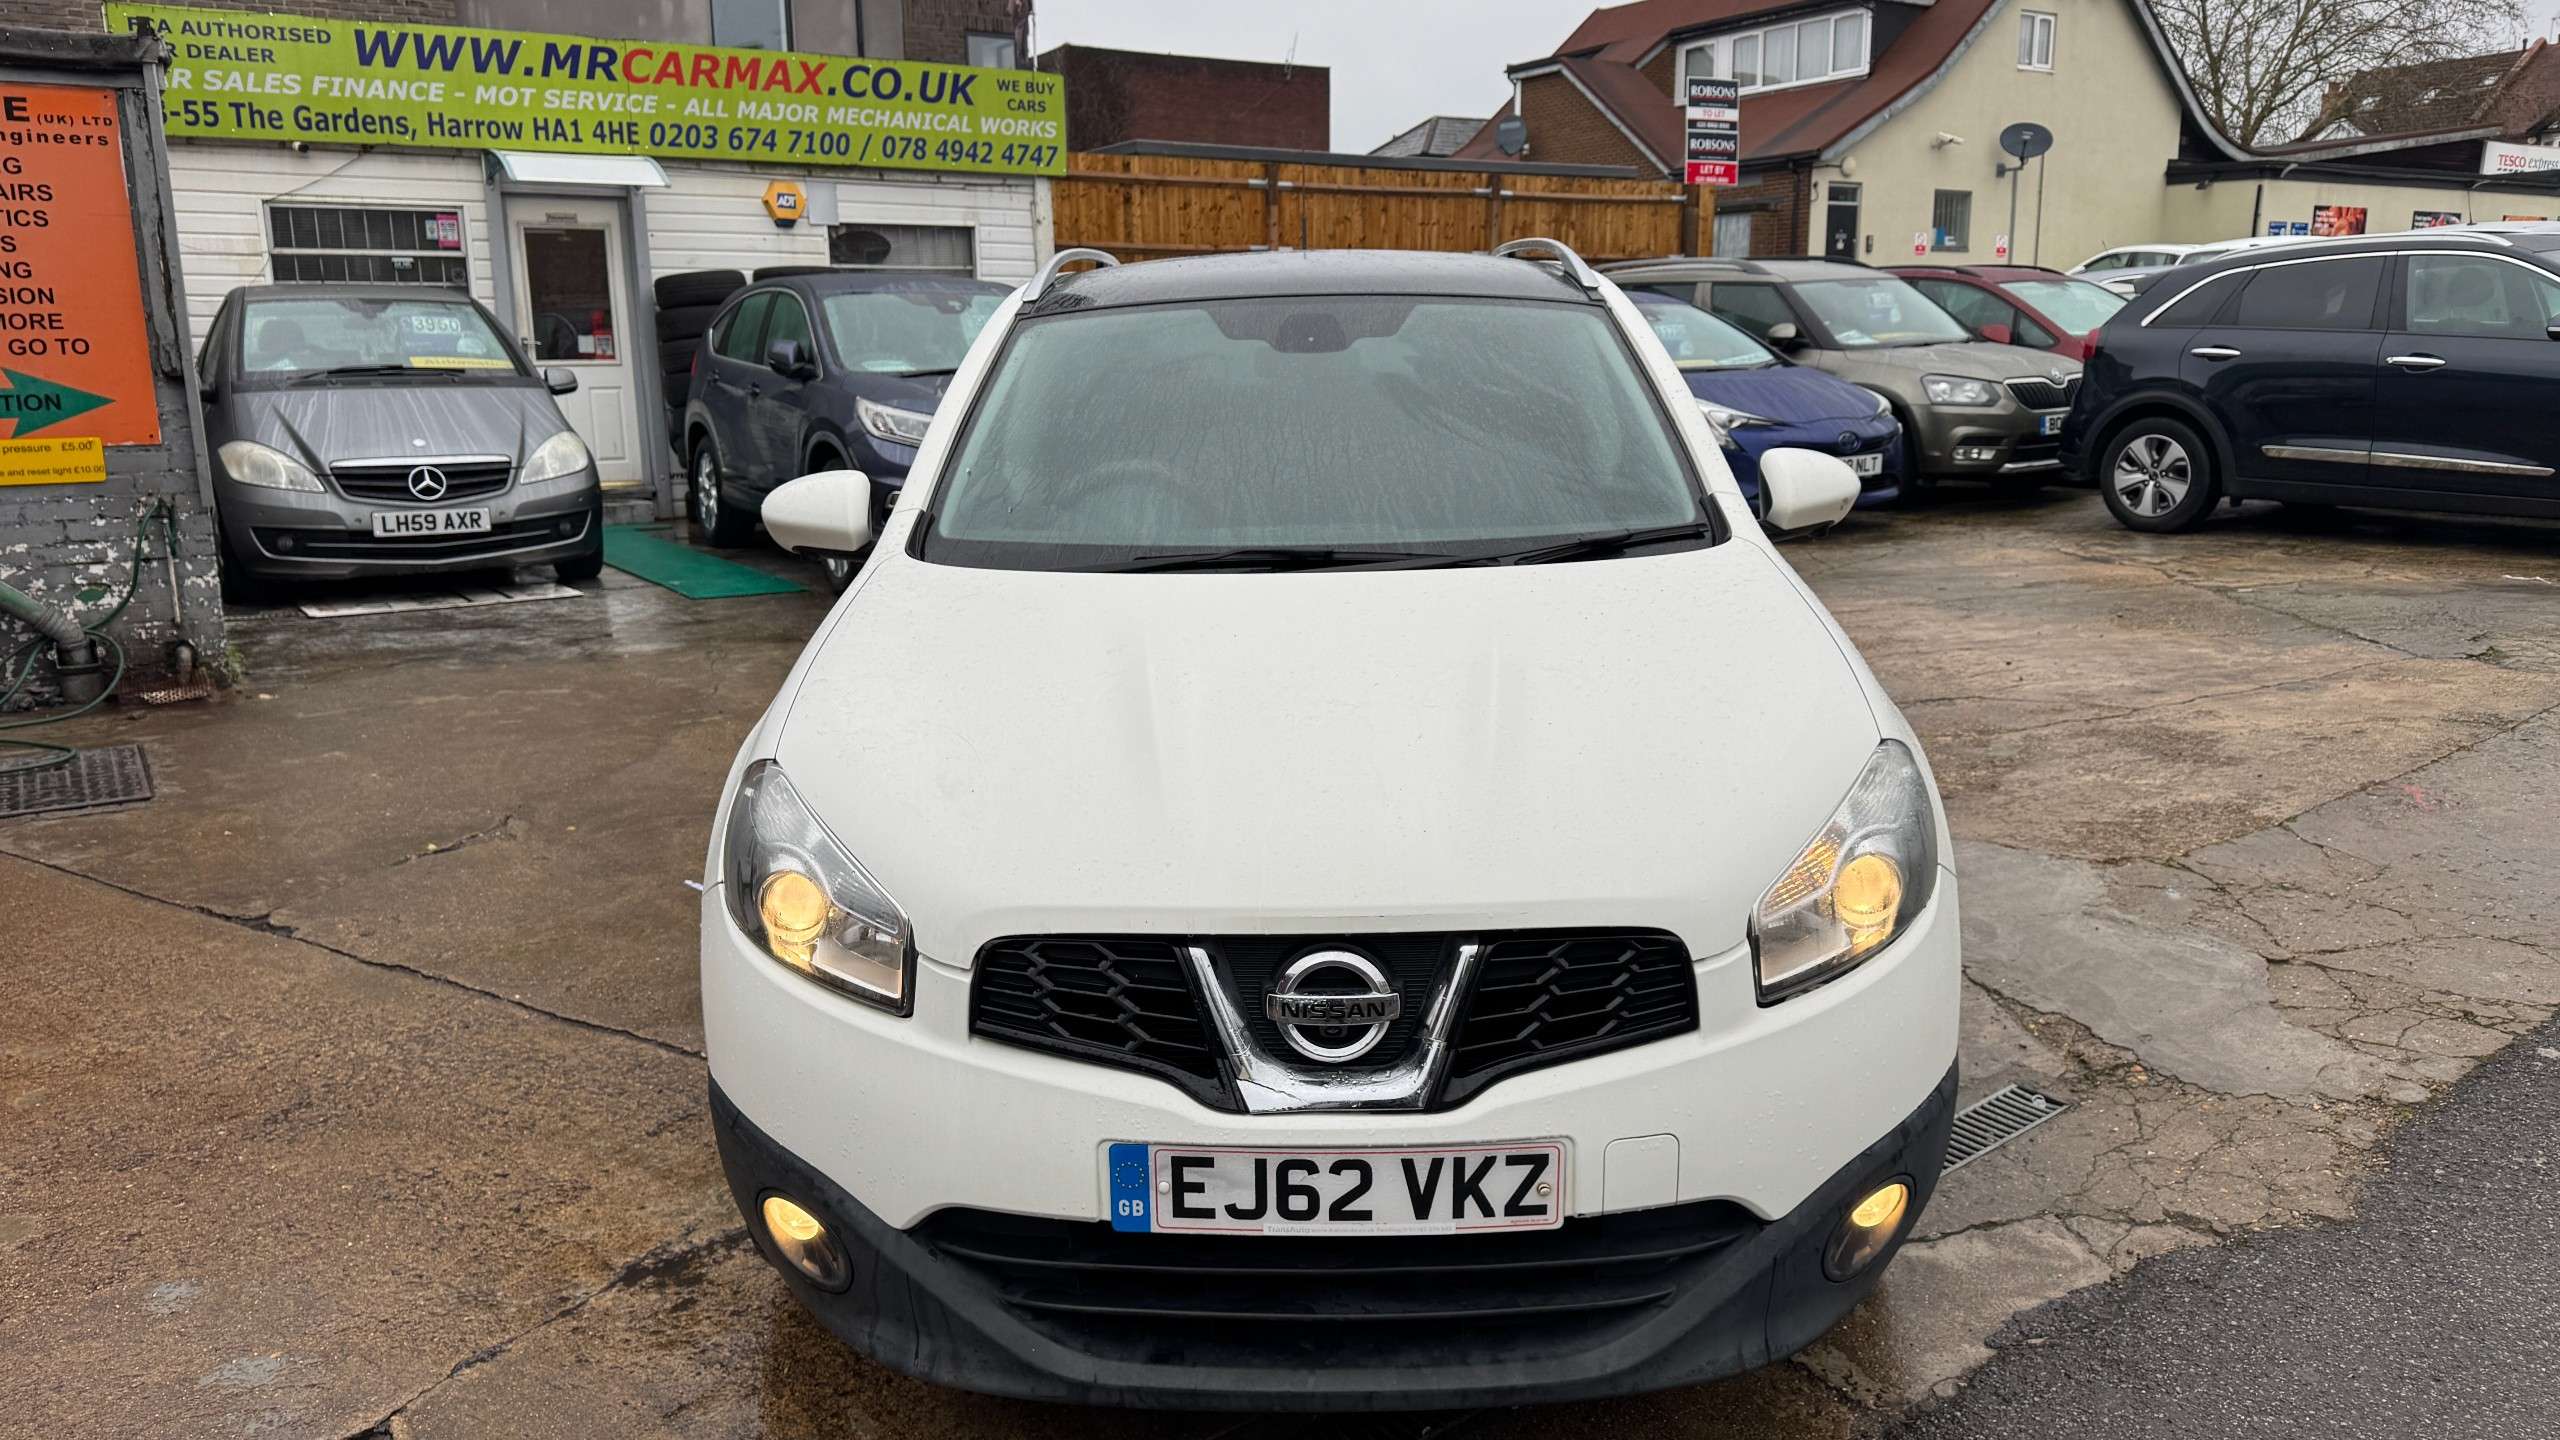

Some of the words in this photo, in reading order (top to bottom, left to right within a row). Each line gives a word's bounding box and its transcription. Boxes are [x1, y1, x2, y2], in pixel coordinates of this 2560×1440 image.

[181, 20, 332, 44] AUTHORISED
[186, 44, 276, 63] DEALER
[354, 28, 978, 106] WWW.MRCARMAX.CO.UK
[997, 79, 1020, 93] WE
[1025, 80, 1055, 95] BUY
[1690, 84, 1736, 99] ROBSONS
[164, 68, 192, 90] R
[203, 70, 302, 95] SALES
[311, 75, 445, 102] FINANCE
[474, 85, 537, 107] MOT
[544, 90, 658, 114] SERVICE
[684, 98, 729, 119] ALL
[737, 101, 819, 124] MAJOR
[827, 106, 973, 133] MECHANICAL
[980, 117, 1058, 139] WORKS
[1007, 98, 1046, 113] CARS
[37, 113, 74, 127] (UK)
[82, 116, 113, 126] LTD
[229, 102, 284, 130] The
[293, 105, 417, 141] Gardens,
[427, 112, 523, 140] Harrow
[533, 117, 583, 143] HA1
[592, 120, 639, 145] 4HE
[650, 122, 719, 149] 0203
[728, 127, 777, 152] 674
[788, 130, 850, 156] 7100
[858, 133, 873, 161] /
[882, 135, 927, 160] 078
[935, 139, 993, 164] 4942
[1001, 143, 1058, 168] 4747
[1690, 138, 1736, 152] ROBSONS
[2498, 154, 2527, 168] TESCO
[8, 338, 48, 356] GO
[55, 338, 90, 356] TO
[2, 442, 52, 455] pressure
[7, 466, 25, 477] and
[27, 466, 51, 476] reset
[1856, 456, 1878, 472] NLT
[381, 513, 437, 533] LH59
[444, 511, 482, 530] AXR
[1281, 1001, 1386, 1019] NISSAN
[1171, 1156, 1373, 1222] EJ62
[1400, 1153, 1551, 1220] VKZ
[1118, 1199, 1144, 1217] GB
